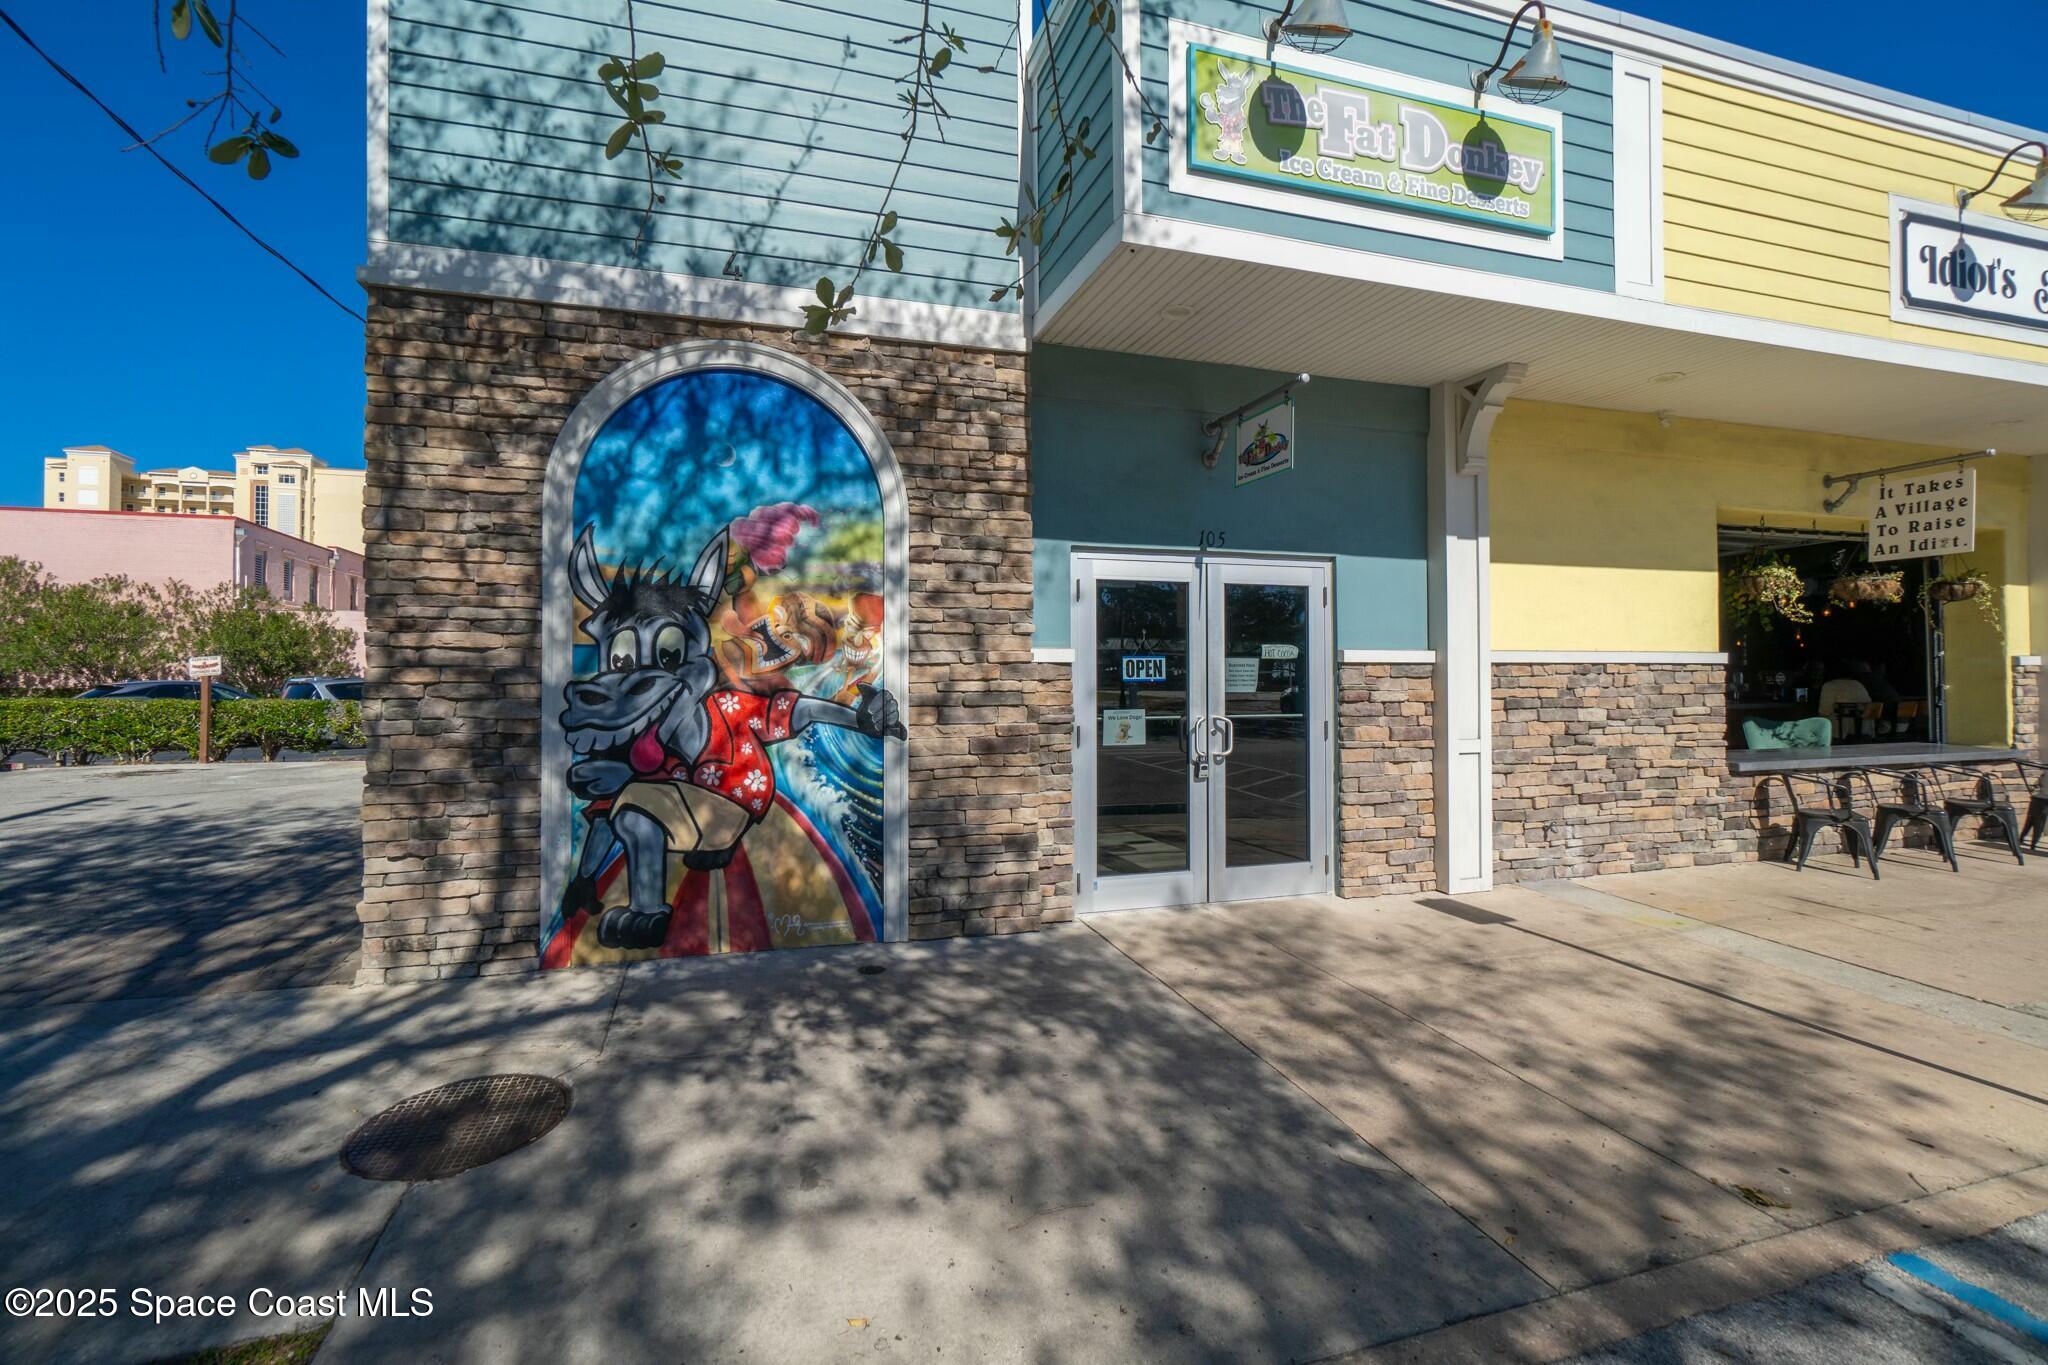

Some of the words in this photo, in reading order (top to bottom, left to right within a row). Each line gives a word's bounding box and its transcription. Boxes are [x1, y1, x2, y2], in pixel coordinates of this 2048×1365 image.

[1263, 84, 1324, 127] The
[1318, 85, 1396, 160] Fat
[1400, 104, 1545, 193] Donkey
[1280, 150, 1312, 175] Ice
[1317, 160, 1384, 190] Cream
[1388, 171, 1401, 191] &
[1405, 176, 1449, 201] Fine
[1454, 188, 1529, 217] Desserts
[1919, 245, 2017, 299] Idiot's
[1880, 487, 1893, 500] It
[1904, 478, 1964, 496] Takes
[1875, 507, 1887, 519] A
[1895, 497, 1969, 516] Village
[1877, 525, 1898, 537] To
[1908, 517, 1966, 533] Raise
[1198, 529, 1225, 548] 105
[1874, 544, 1900, 556] An
[1125, 659, 1163, 678] OPEN
